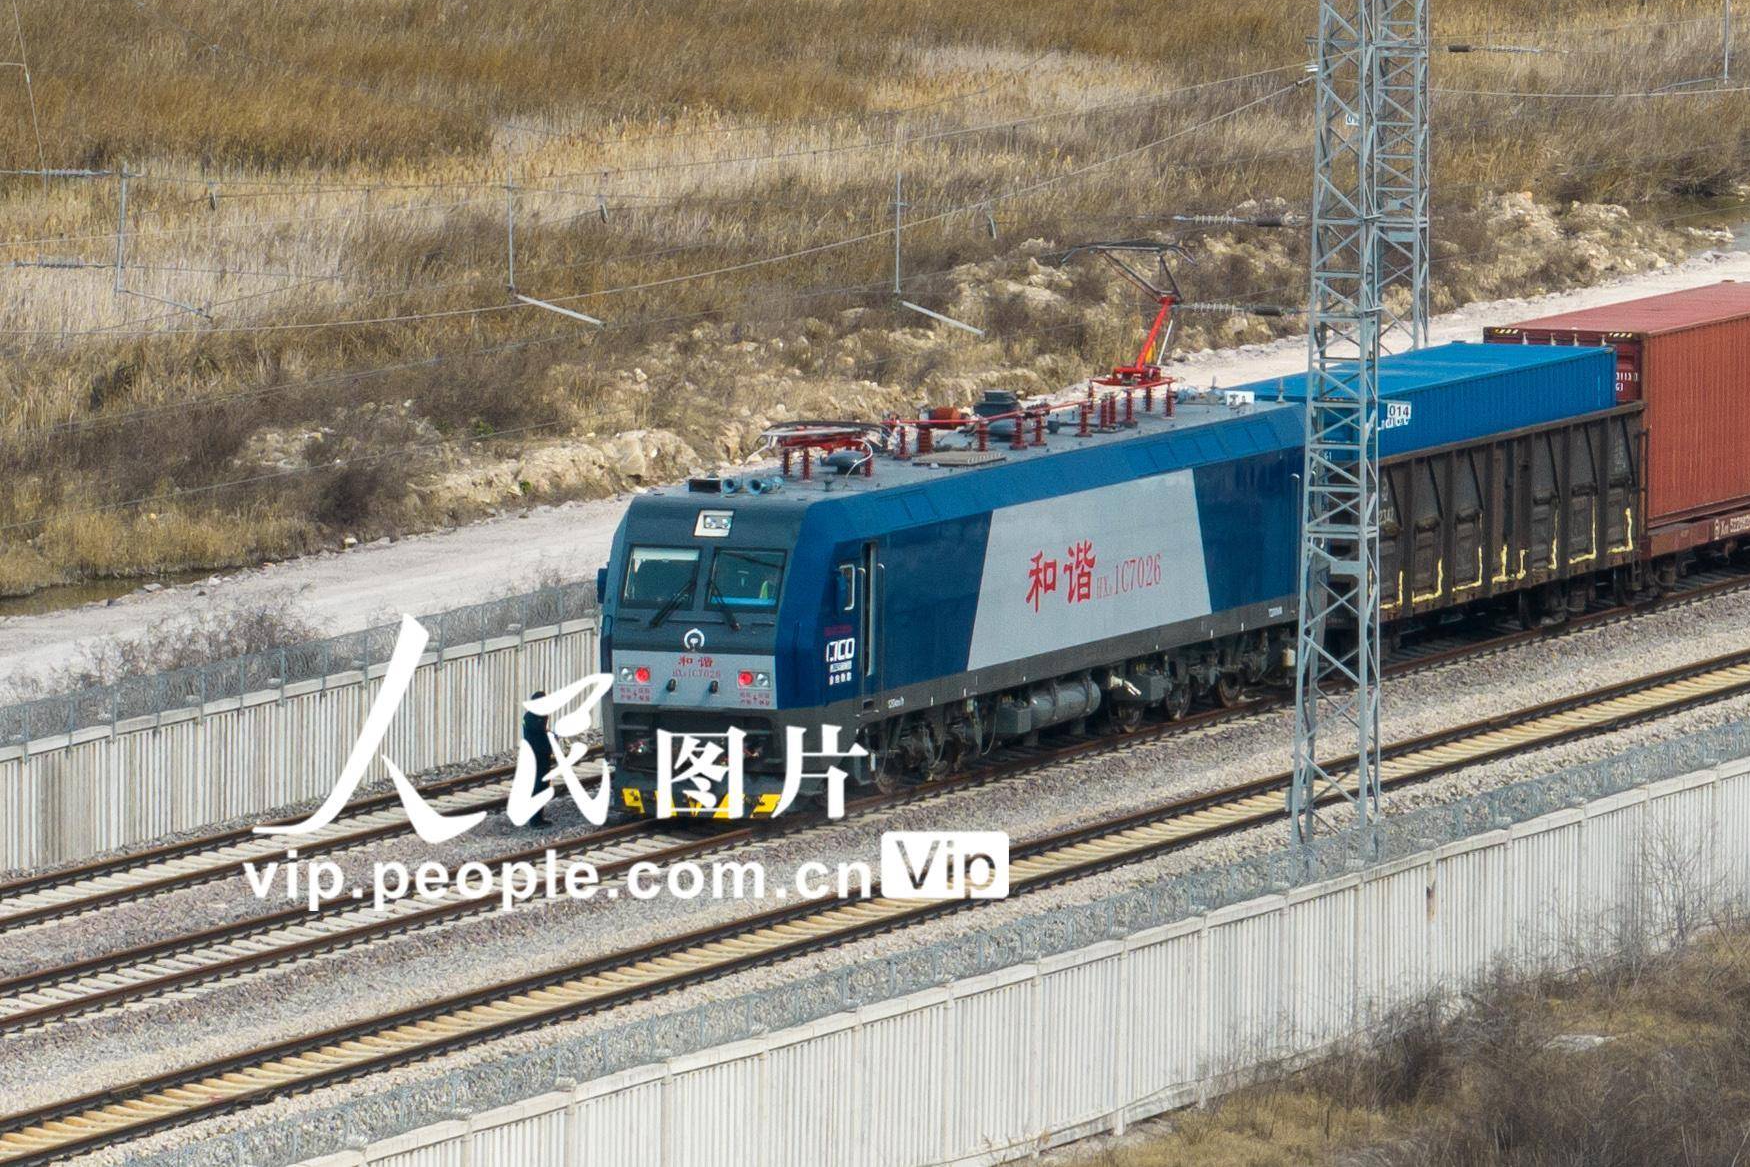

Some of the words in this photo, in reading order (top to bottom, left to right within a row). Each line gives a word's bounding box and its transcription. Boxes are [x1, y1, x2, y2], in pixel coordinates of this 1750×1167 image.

[1389, 405, 1409, 418] 014
[1025, 539, 1097, 613] 和谐
[677, 655, 714, 668] 和谐
